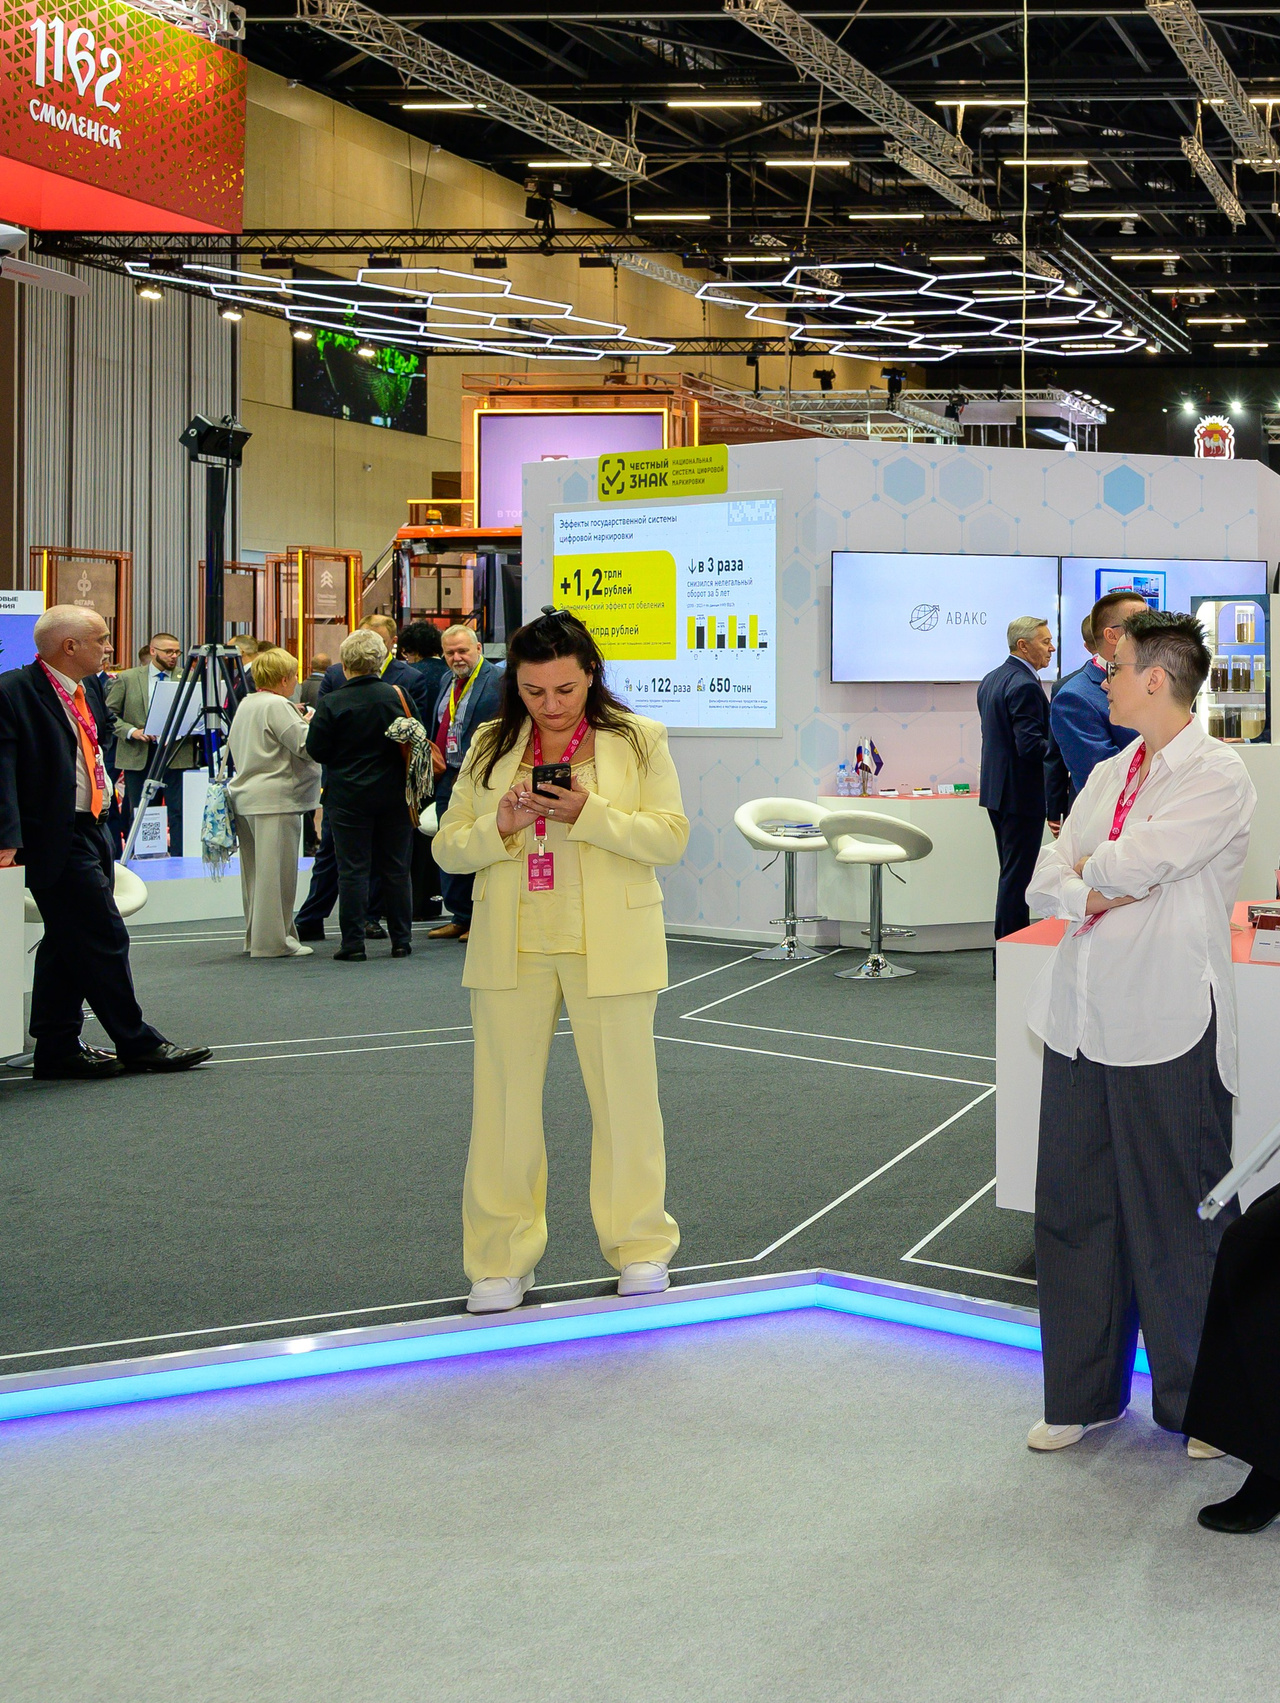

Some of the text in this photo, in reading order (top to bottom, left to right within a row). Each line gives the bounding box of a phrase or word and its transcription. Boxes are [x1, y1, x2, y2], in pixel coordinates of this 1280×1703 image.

[29, 15, 122, 114] 1162
[29, 98, 122, 150] СМОЛЕНСК
[629, 458, 669, 471] ЧЕСТНЫЙ
[672, 456, 713, 466] НАЦИОНАЛЬНАЯ
[672, 465, 724, 476] СИСТЕМА ЦИФРОВОЙ
[629, 472, 669, 489] ЗНАК
[672, 478, 705, 486] МАРКИРОВКИ
[559, 515, 677, 530] Эффекты государственной системы
[559, 532, 634, 544] цифровой маркировки
[708, 557, 714, 573] 3
[717, 559, 744, 576] раза
[560, 568, 622, 601] +1,2 трлн
[604, 584, 632, 597] рублей
[946, 611, 987, 625] АВАКС
[611, 624, 639, 638] рублей
[651, 678, 671, 693] 122
[673, 684, 691, 695] раза
[709, 678, 752, 693] 650 тонн
